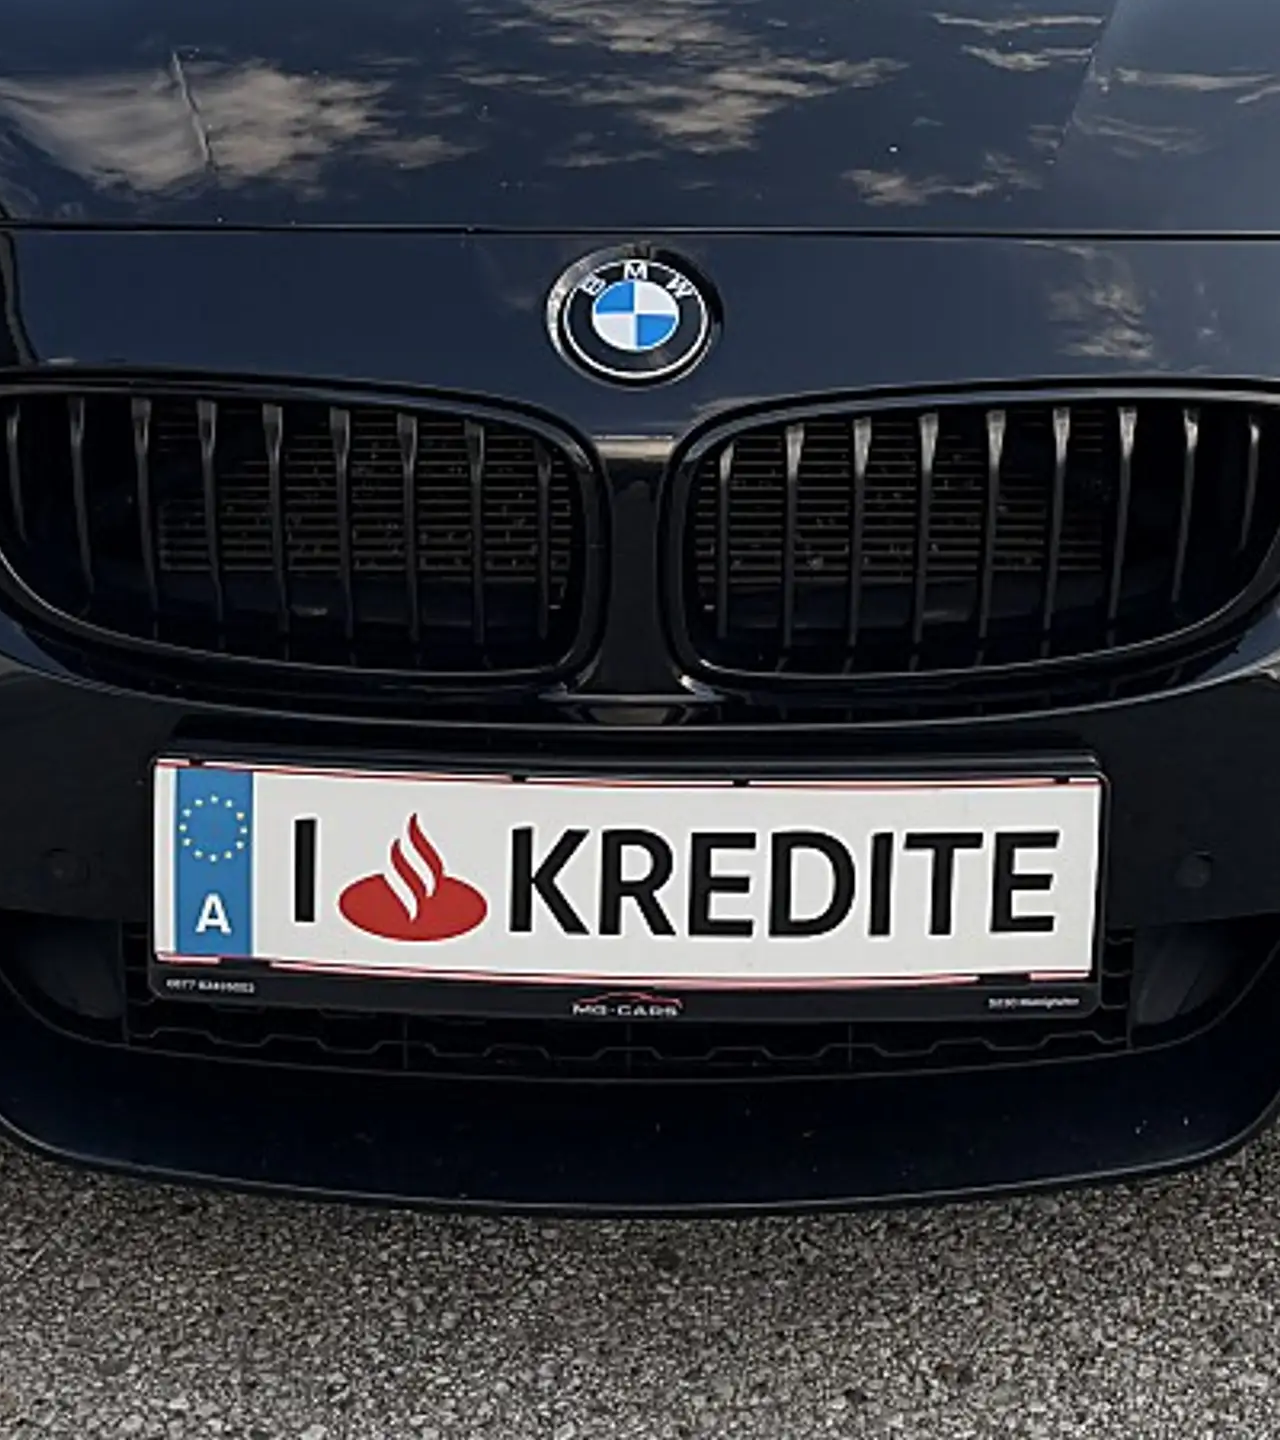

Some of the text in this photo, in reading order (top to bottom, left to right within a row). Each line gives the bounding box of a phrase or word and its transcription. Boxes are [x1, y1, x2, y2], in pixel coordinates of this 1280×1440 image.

[577, 259, 697, 299] BMW
[294, 817, 1060, 937] I KREDITE
[196, 893, 231, 934] A
